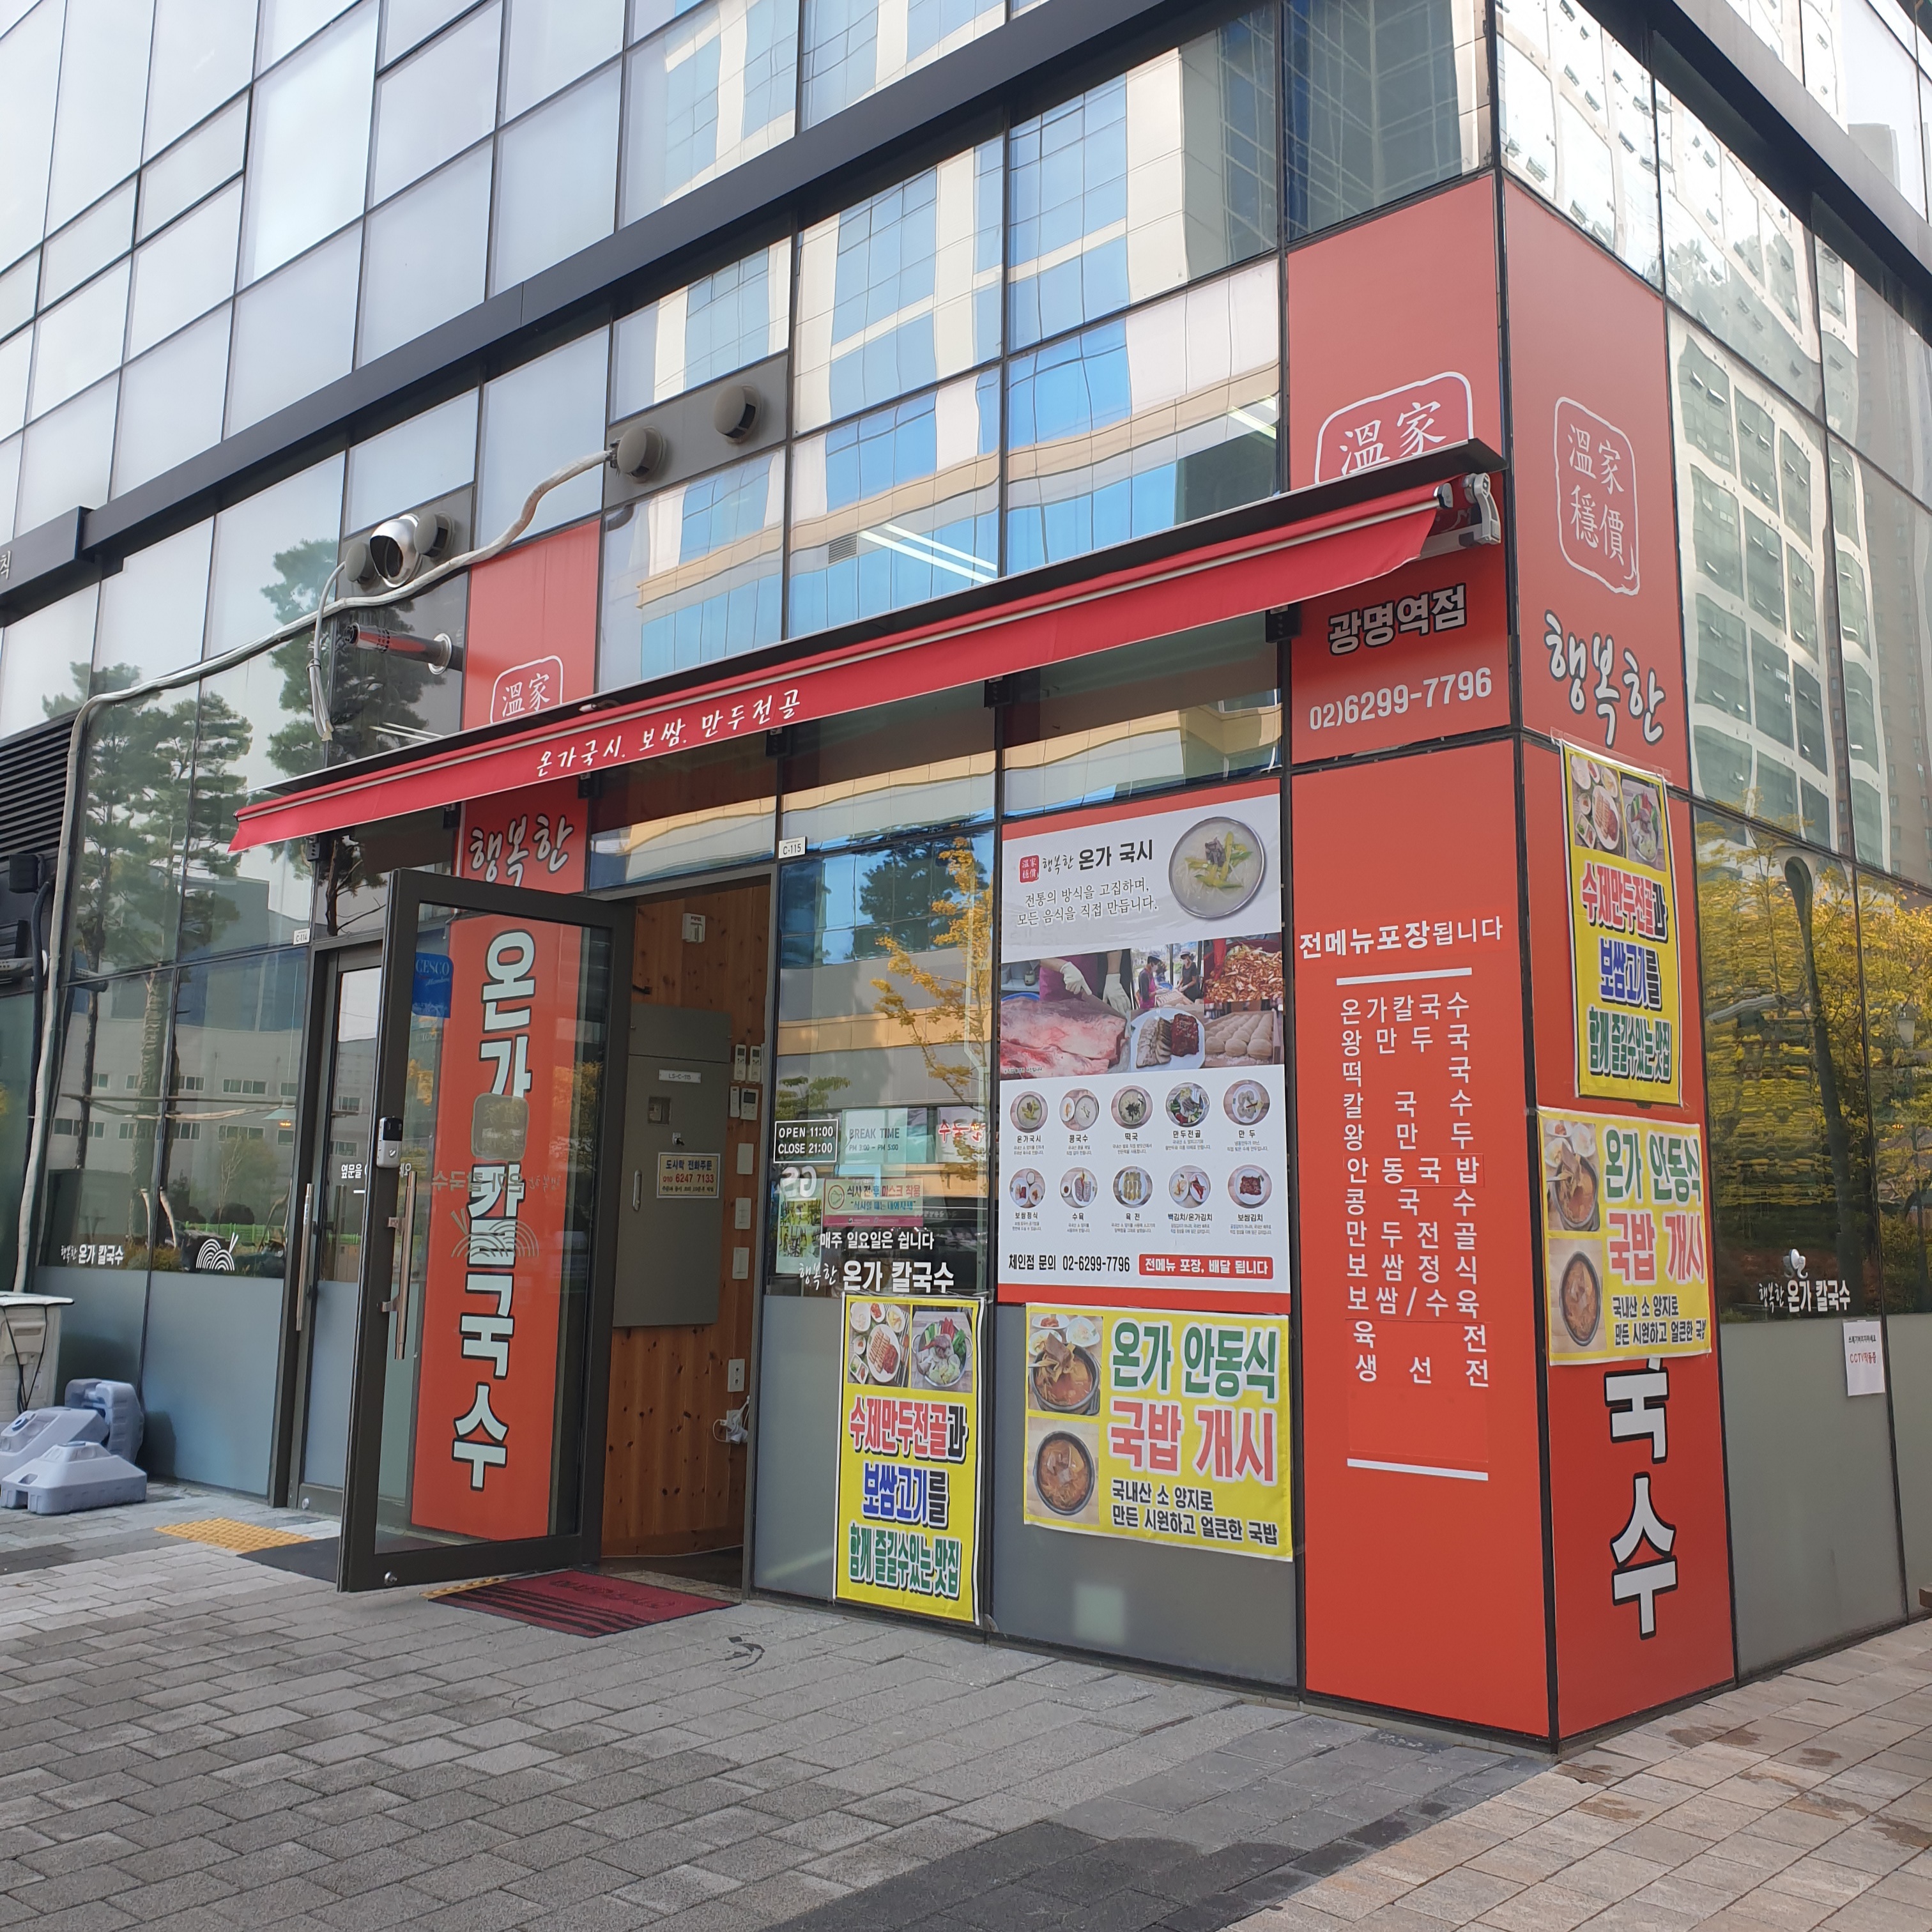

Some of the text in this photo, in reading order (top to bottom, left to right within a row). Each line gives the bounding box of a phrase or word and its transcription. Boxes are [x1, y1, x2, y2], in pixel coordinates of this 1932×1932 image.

[1330, 585, 1466, 656] 광명역점
[1544, 610, 1665, 746] 행복한
[702, 689, 801, 739] 만두전골
[1310, 666, 1492, 730] 02)6299-7796
[470, 814, 574, 887] 행복한
[783, 843, 801, 855] C-115
[1042, 839, 1153, 875] 행복한 온가 국시
[1025, 877, 1149, 908] 전통의 방식을 고집하며,
[1581, 862, 1667, 938] 수제만두전골과
[1017, 894, 1158, 926] 모든 음식을 직접 만듭니다.
[1299, 915, 1503, 960] 전메뉴포장됩니다
[416, 959, 450, 976] CESCO
[1600, 937, 1660, 1006] 보쌈고기를
[1590, 1006, 1608, 1070] 함께
[1655, 1020, 1669, 1080] 맛집
[778, 1142, 832, 1154] CLOSE 21:00
[779, 1126, 833, 1138] OPEN 11:00
[849, 1128, 900, 1139] BREAK TIME
[1016, 1135, 1041, 1143] 온가국시
[1069, 1133, 1089, 1143] 콩국수
[1124, 1133, 1138, 1141] 떡국
[1173, 1130, 1200, 1138] 만두전골
[666, 1160, 684, 1170] 도시락
[675, 1173, 693, 1183] 6247
[696, 1174, 714, 1183] 7133
[1606, 1128, 1701, 1202] 온가 안동식
[847, 1185, 862, 1197] 식사
[905, 1185, 920, 1197] 착용
[1072, 1213, 1084, 1221] 수육
[1238, 1213, 1263, 1222] 보쌈김치
[79, 1244, 96, 1264] 온가
[98, 1245, 124, 1265] 칼국수
[820, 1230, 934, 1250] 매주 일요일은 쉽니다
[1609, 1213, 1705, 1281] 국밥 개시
[799, 1260, 954, 1293] 행복한 온가 칼국수
[1009, 1254, 1130, 1272] 체인점 문의 02-6299-7796
[1145, 1258, 1268, 1275] 전메뉴 포장, 배달 됩니다
[1613, 1295, 1679, 1318] 국내산 소 양지로
[1759, 1280, 1851, 1314] 행복한 온가 칼국수
[1615, 1319, 1707, 1346] 만든 시원하고 얼큰한 국밥
[1112, 1321, 1277, 1400] 온가 안동식
[850, 1396, 966, 1459] 수제만두전골과
[1110, 1400, 1274, 1482] 국밥 개시
[862, 1462, 946, 1524] 보쌈고기를
[1112, 1479, 1214, 1511] 국내산 소 양지로
[1112, 1505, 1278, 1545] 만든 시원하고 얼큰한 국밥
[850, 1522, 873, 1580] 함께
[935, 1538, 959, 1595] 맛집
